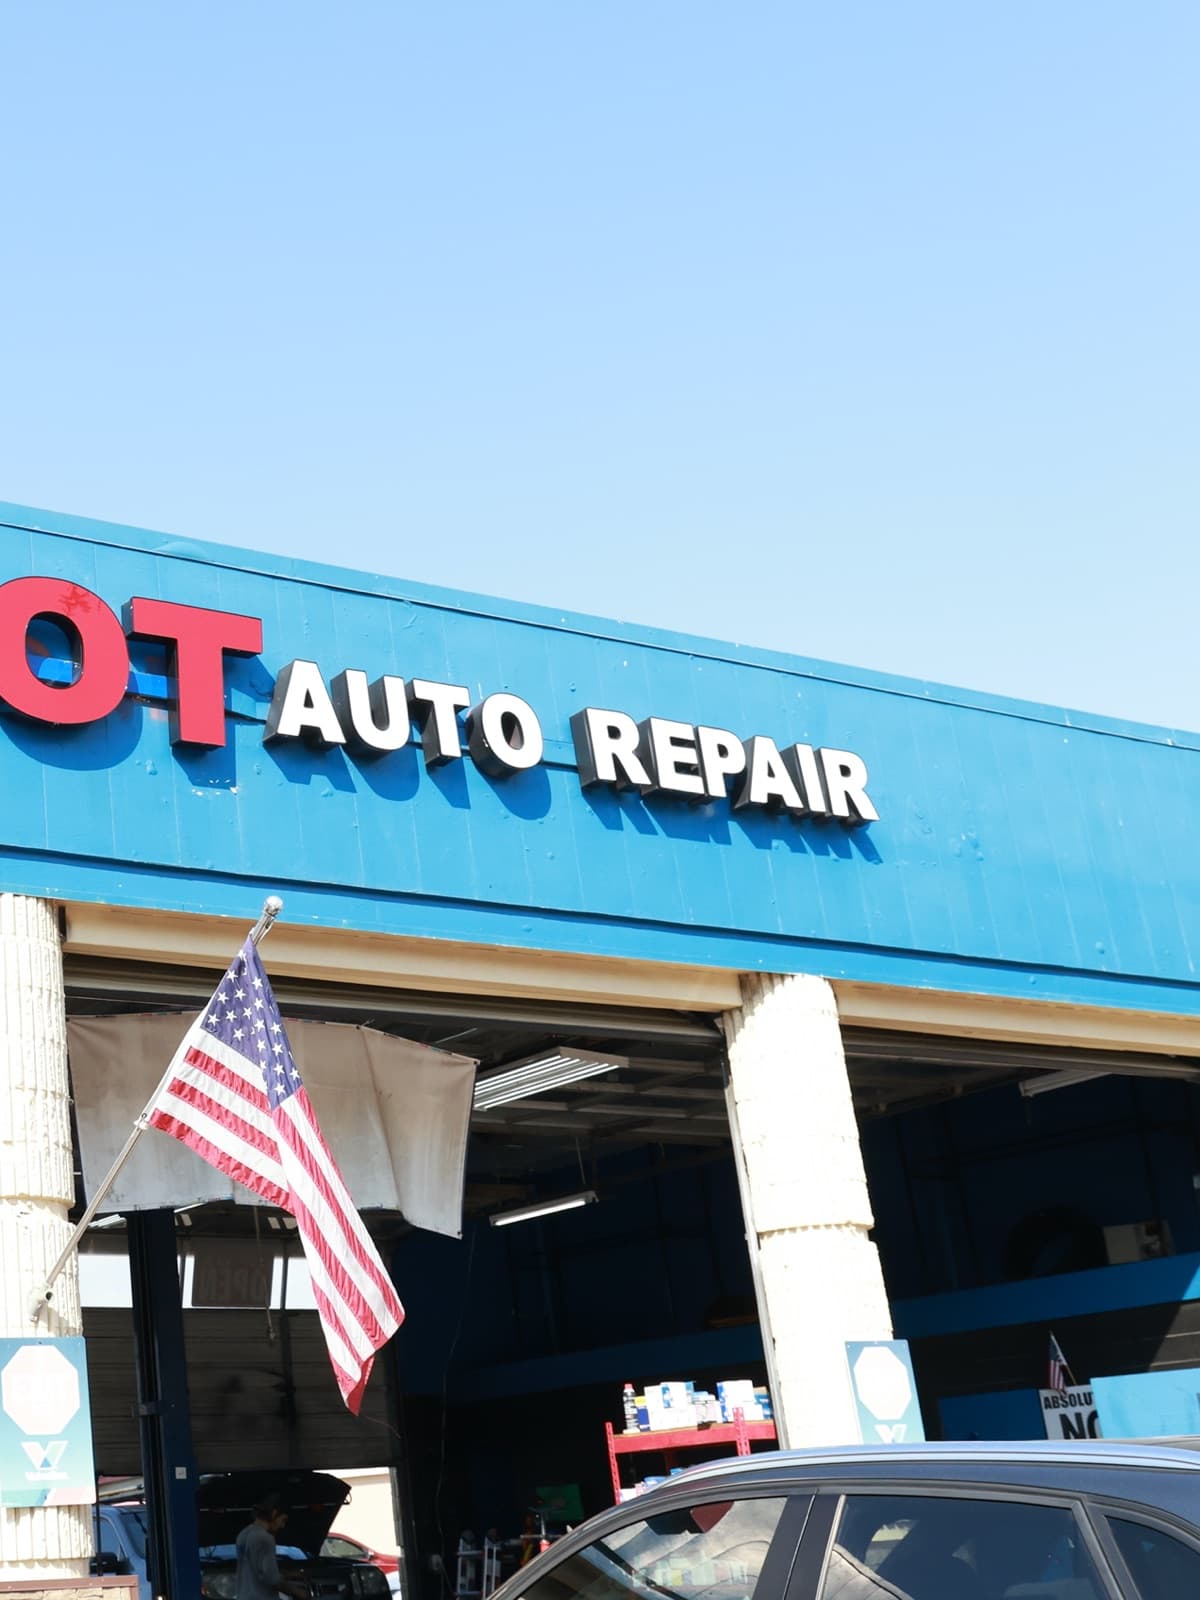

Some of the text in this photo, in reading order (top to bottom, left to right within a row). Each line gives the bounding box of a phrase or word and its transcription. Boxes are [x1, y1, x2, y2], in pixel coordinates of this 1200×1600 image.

[265, 659, 881, 826] AUTO REPAIR
[1043, 1391, 1094, 1410] ABSOLU
